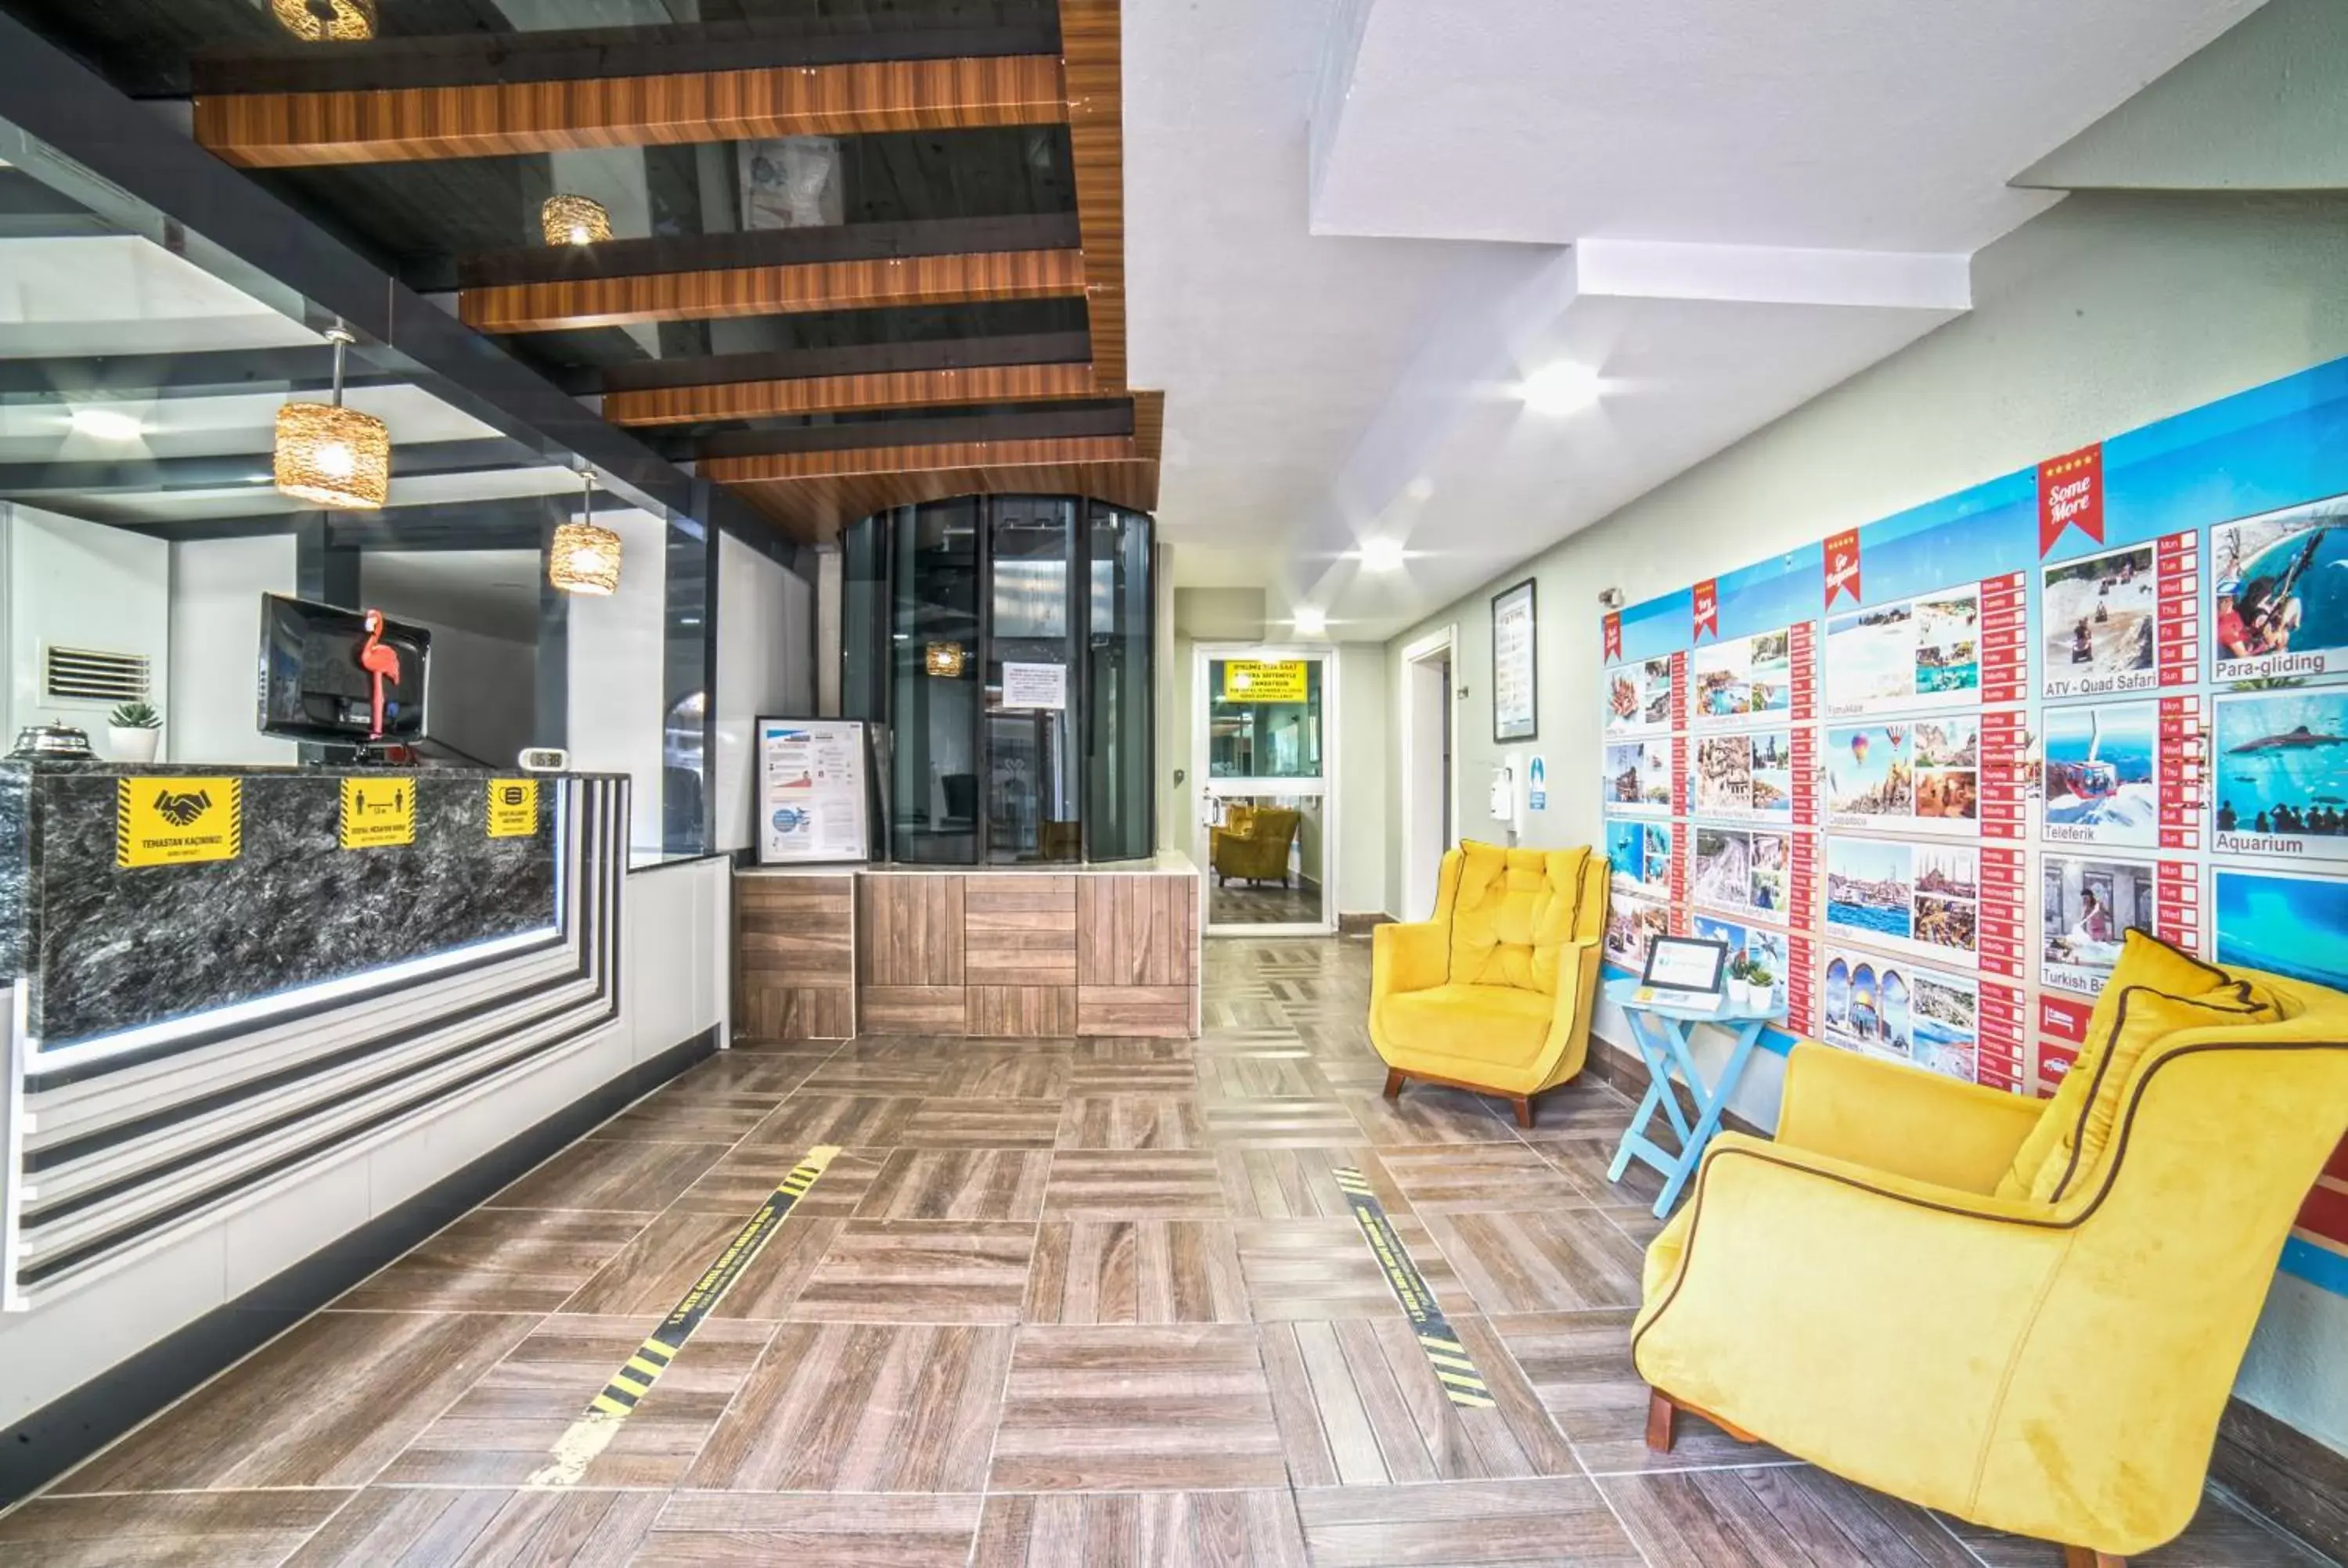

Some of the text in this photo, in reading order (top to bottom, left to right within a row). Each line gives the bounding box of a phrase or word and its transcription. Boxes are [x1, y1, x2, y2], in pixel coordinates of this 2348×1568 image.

[2048, 477, 2091, 505] Some
[2051, 494, 2090, 524] More
[2160, 540, 2178, 549] Mon
[2161, 560, 2177, 570] Tue
[2161, 583, 2181, 593] Wed
[2162, 606, 2177, 615] Thu
[2216, 655, 2325, 678] Para-gliding
[2162, 671, 2177, 680] Sun
[2046, 680, 2068, 696] ATV
[2080, 677, 2112, 693] Quad
[2117, 674, 2156, 689] Safari
[2163, 701, 2180, 710] Mon
[2163, 723, 2178, 732] Tue
[2163, 745, 2181, 754] Wed
[2163, 767, 2178, 776] Thu
[2163, 789, 2173, 798] Fri
[2044, 825, 2094, 840] Teleferik
[2216, 833, 2303, 853] Aquarium
[2161, 865, 2178, 875] Mon
[2161, 886, 2177, 897] Tue
[2161, 909, 2180, 919] Wed
[2162, 931, 2177, 941] Thu
[2042, 968, 2087, 990] Turkish
